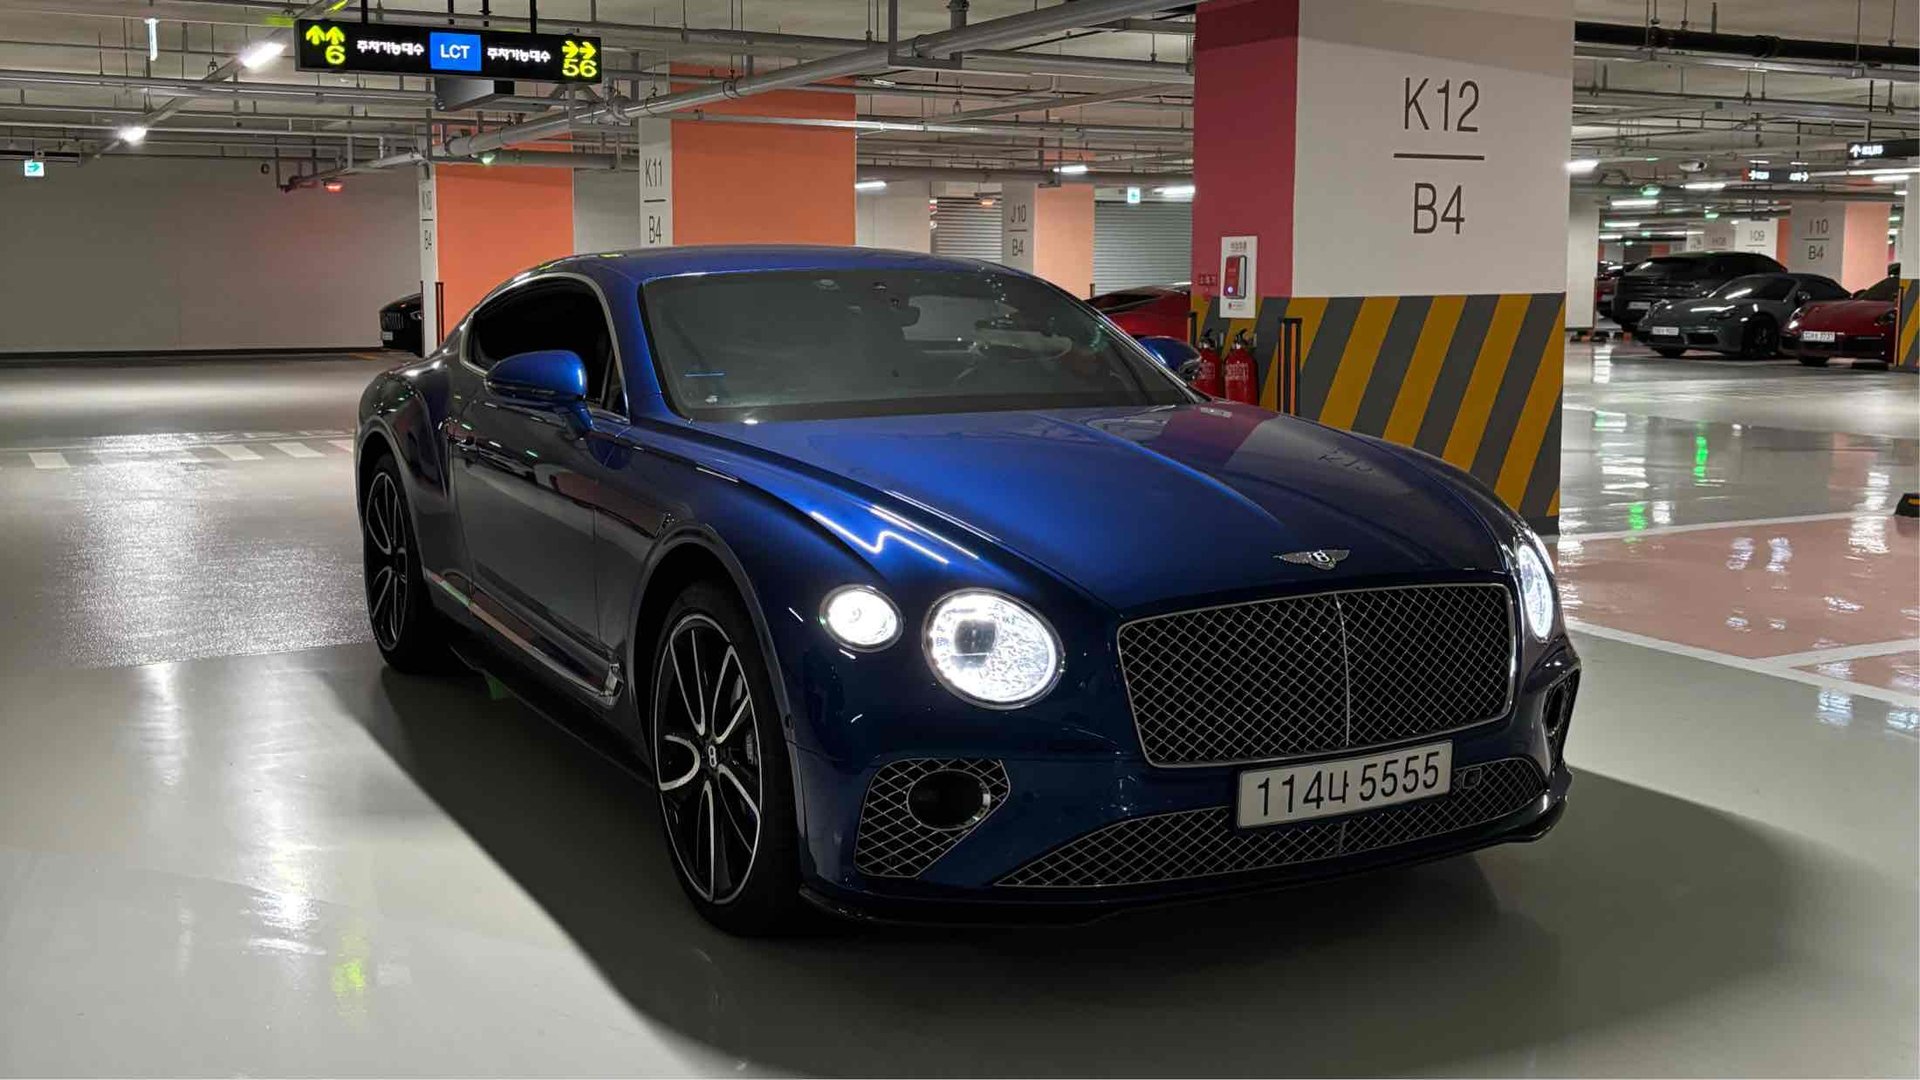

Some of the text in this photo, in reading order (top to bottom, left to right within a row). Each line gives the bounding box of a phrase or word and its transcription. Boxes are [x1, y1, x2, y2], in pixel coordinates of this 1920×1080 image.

[325, 45, 345, 65] 6
[440, 44, 470, 60] LCT
[562, 58, 598, 77] 56
[1403, 77, 1480, 132] K12
[645, 159, 663, 188] K11
[1010, 204, 1027, 223] J10
[1412, 182, 1466, 235] B4
[648, 215, 662, 244] B4
[1012, 238, 1024, 257] B4
[1808, 245, 1824, 260] B4
[1258, 751, 1440, 817] 114나 5555
